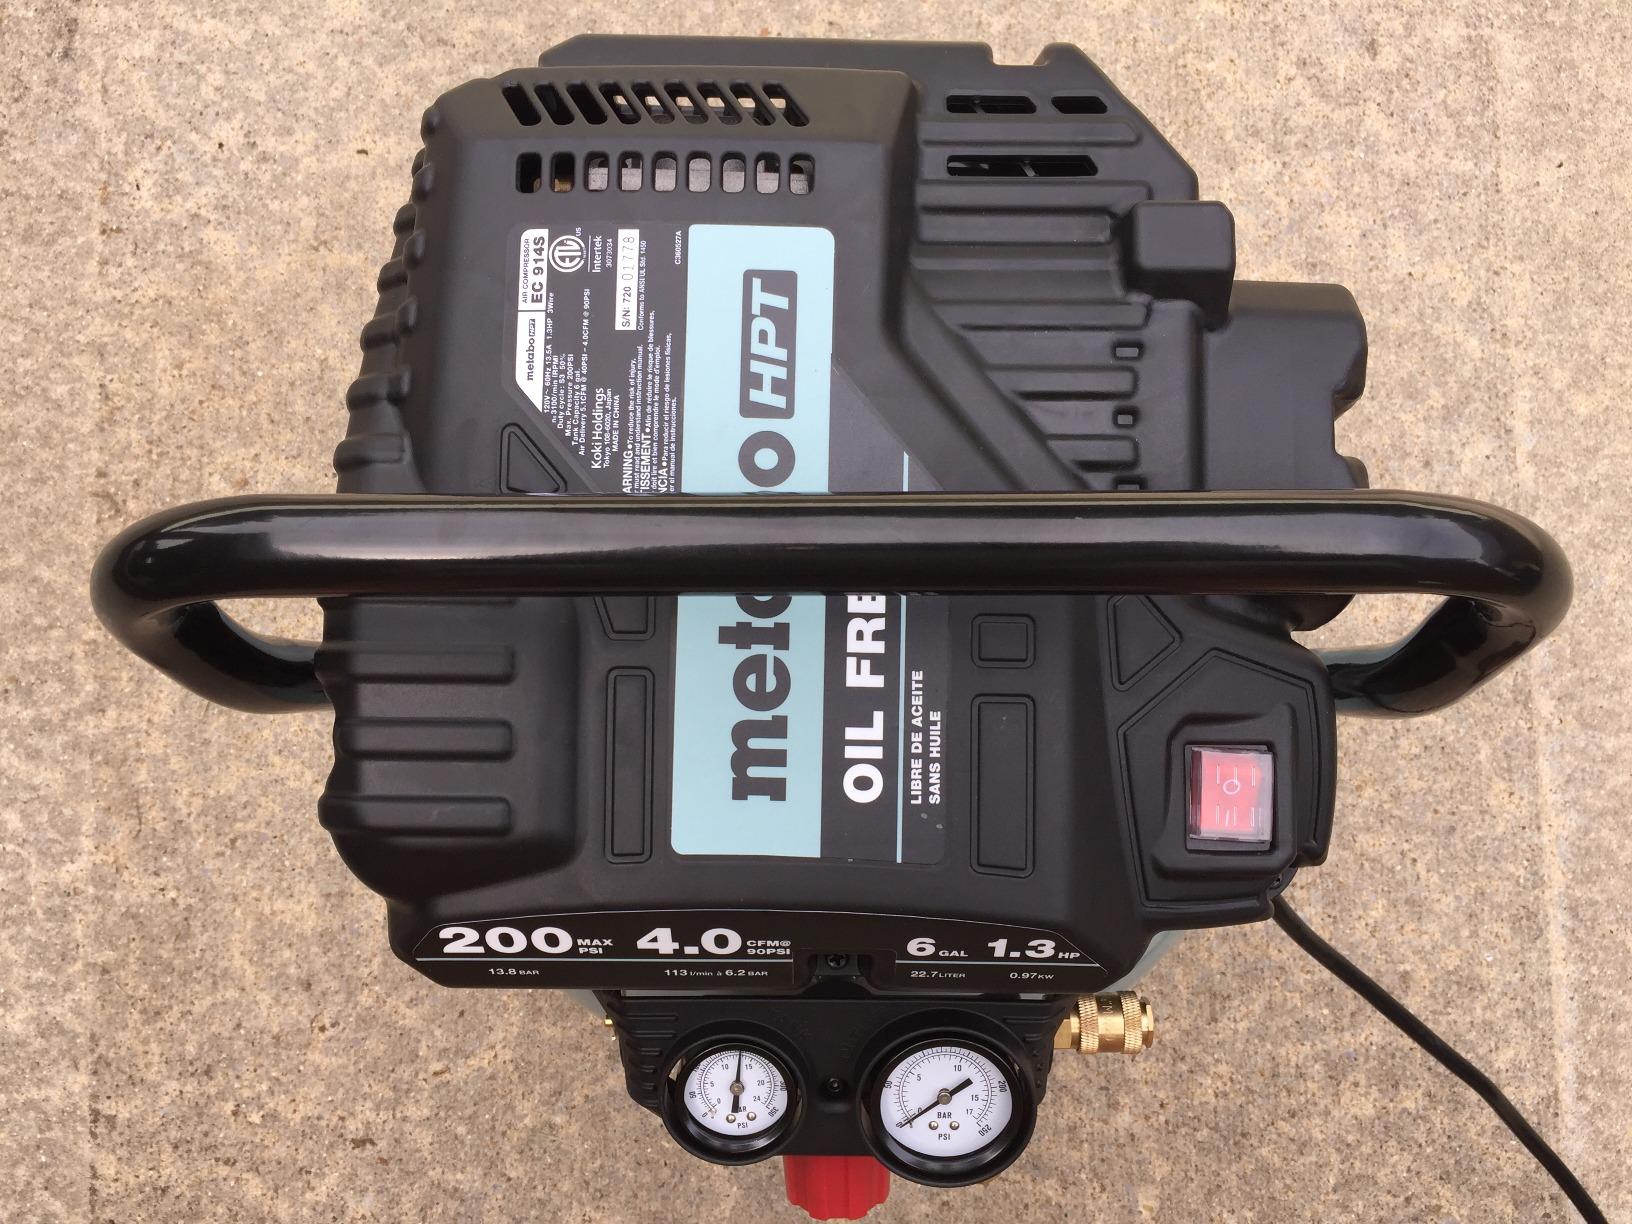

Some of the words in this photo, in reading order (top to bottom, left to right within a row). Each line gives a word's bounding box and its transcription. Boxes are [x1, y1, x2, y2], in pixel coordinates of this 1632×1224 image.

[533, 236, 545, 275] 914S
[592, 236, 602, 272] Intertek
[531, 282, 543, 303] EC
[623, 287, 631, 303] 720
[622, 307, 630, 327] S/N:
[749, 277, 789, 409] HPT
[526, 338, 535, 381] metabo
[559, 374, 565, 383] S3
[664, 384, 670, 392] de
[573, 392, 581, 424] Capacity
[605, 389, 613, 409] Japan
[592, 388, 606, 439] Holdings
[622, 451, 633, 493] ARNING
[629, 358, 637, 377] injury,
[591, 443, 602, 468] Koki
[603, 447, 611, 468] Tokyo
[669, 443, 675, 451] de
[640, 433, 651, 492] ISSEMENT
[845, 595, 886, 688] FRE
[911, 670, 924, 728] ACEITE
[911, 732, 923, 753] DE
[929, 711, 942, 757] HUILE
[842, 710, 884, 804] OIL
[910, 758, 923, 804] LIBRE
[929, 762, 941, 804] SANS
[438, 926, 573, 954] 200
[576, 938, 614, 946] MAX
[636, 927, 743, 955] 4.0
[907, 937, 936, 957] 6
[988, 938, 1055, 958] 1.3
[488, 968, 518, 976] 13.8
